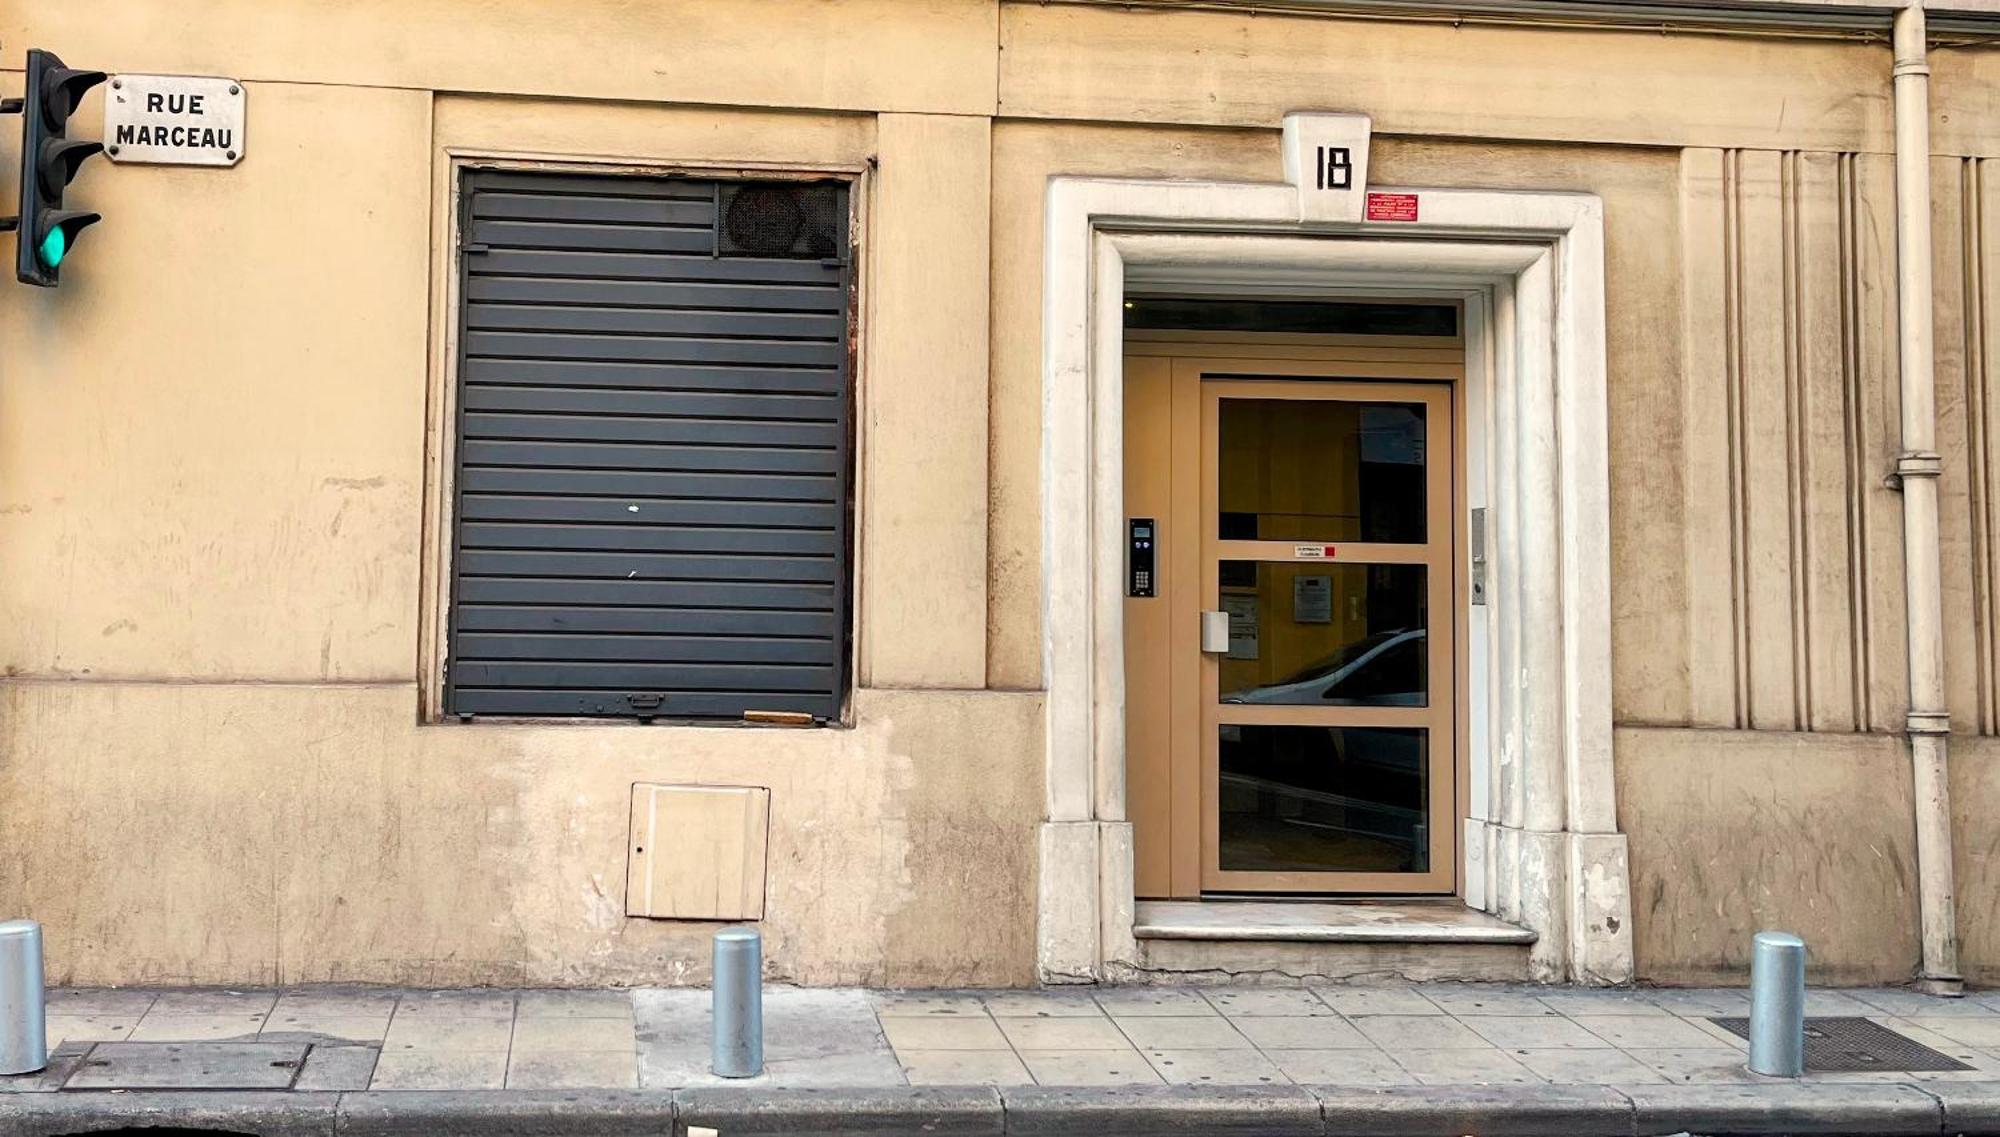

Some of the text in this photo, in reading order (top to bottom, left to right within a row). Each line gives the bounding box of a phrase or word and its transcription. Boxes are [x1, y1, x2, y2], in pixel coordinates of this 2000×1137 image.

[147, 93, 205, 115] RUE
[116, 125, 232, 149] MARCEAU
[1317, 146, 1352, 191] 18
